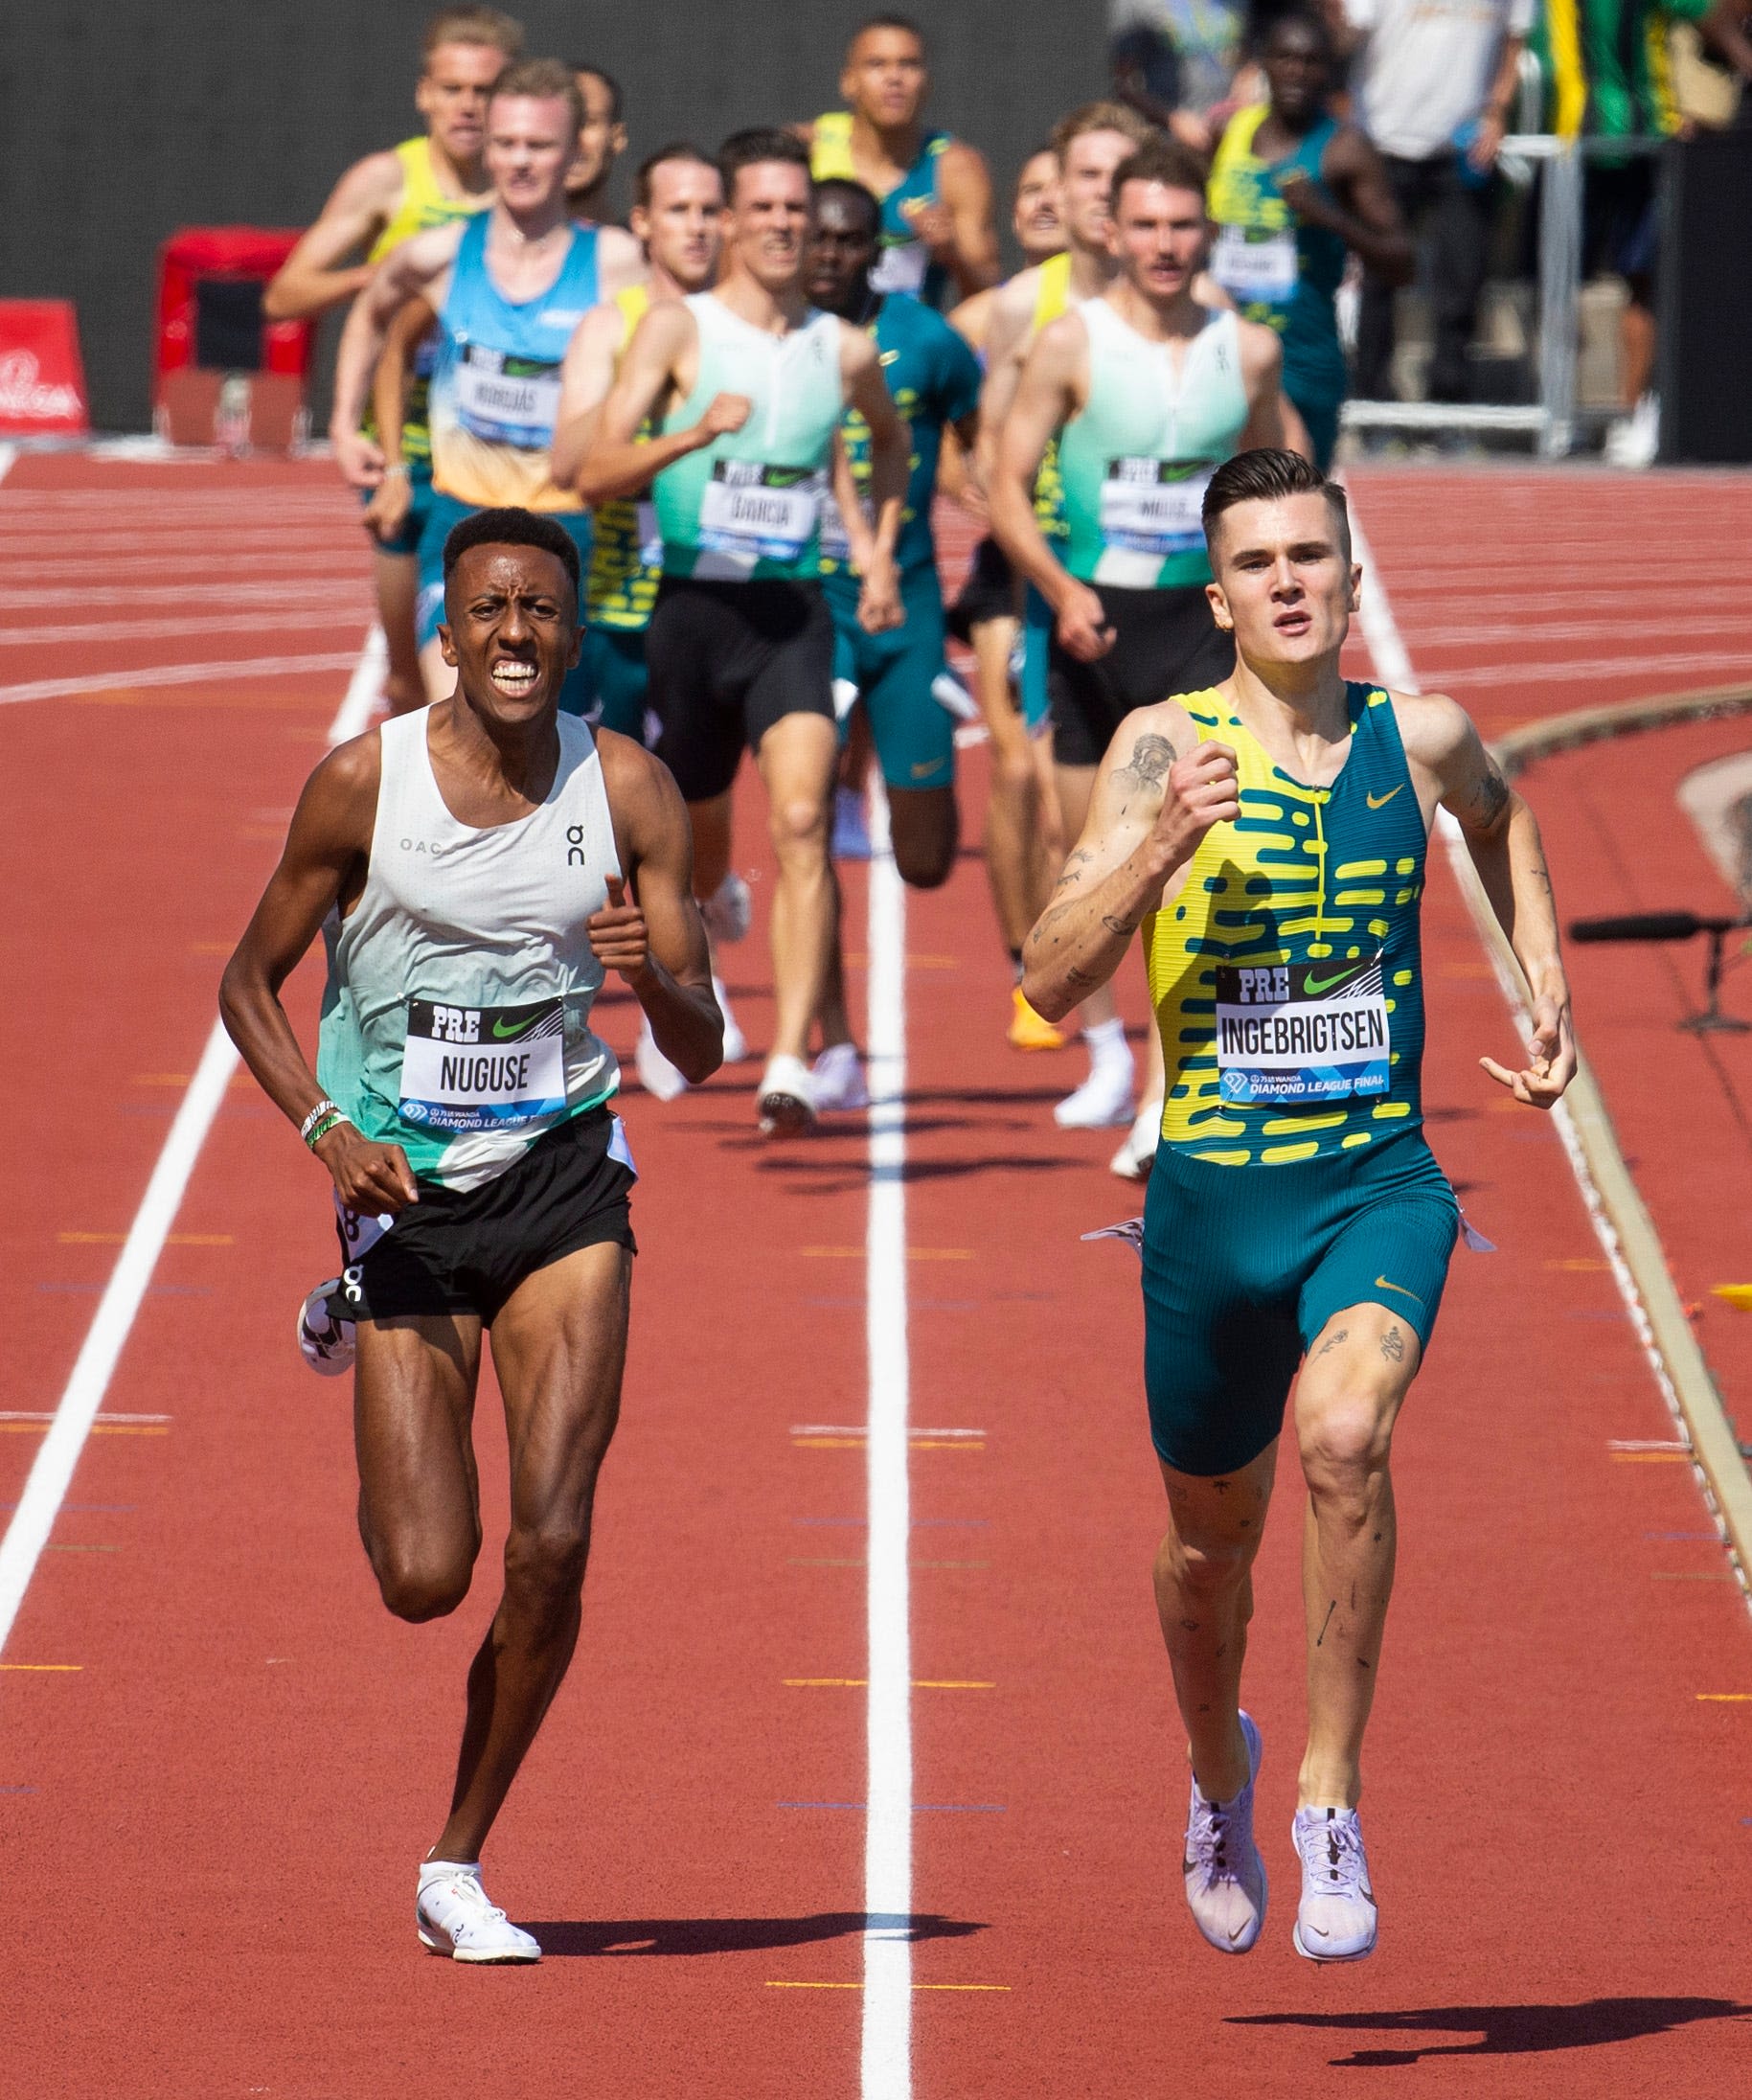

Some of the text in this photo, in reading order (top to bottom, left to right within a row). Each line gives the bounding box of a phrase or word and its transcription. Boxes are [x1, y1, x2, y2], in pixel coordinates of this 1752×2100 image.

[400, 837, 443, 856] OAC
[1239, 967, 1290, 1003] PRE
[431, 1006, 481, 1043] PRE
[1221, 1008, 1384, 1055] INGEBRIGTSEN
[440, 1053, 530, 1092] NUGUSE
[1249, 1074, 1384, 1094] DIAMOND LEAGUE FINAL
[428, 1116, 483, 1130] DIAMOND
[484, 1115, 528, 1129] LEAGUE
